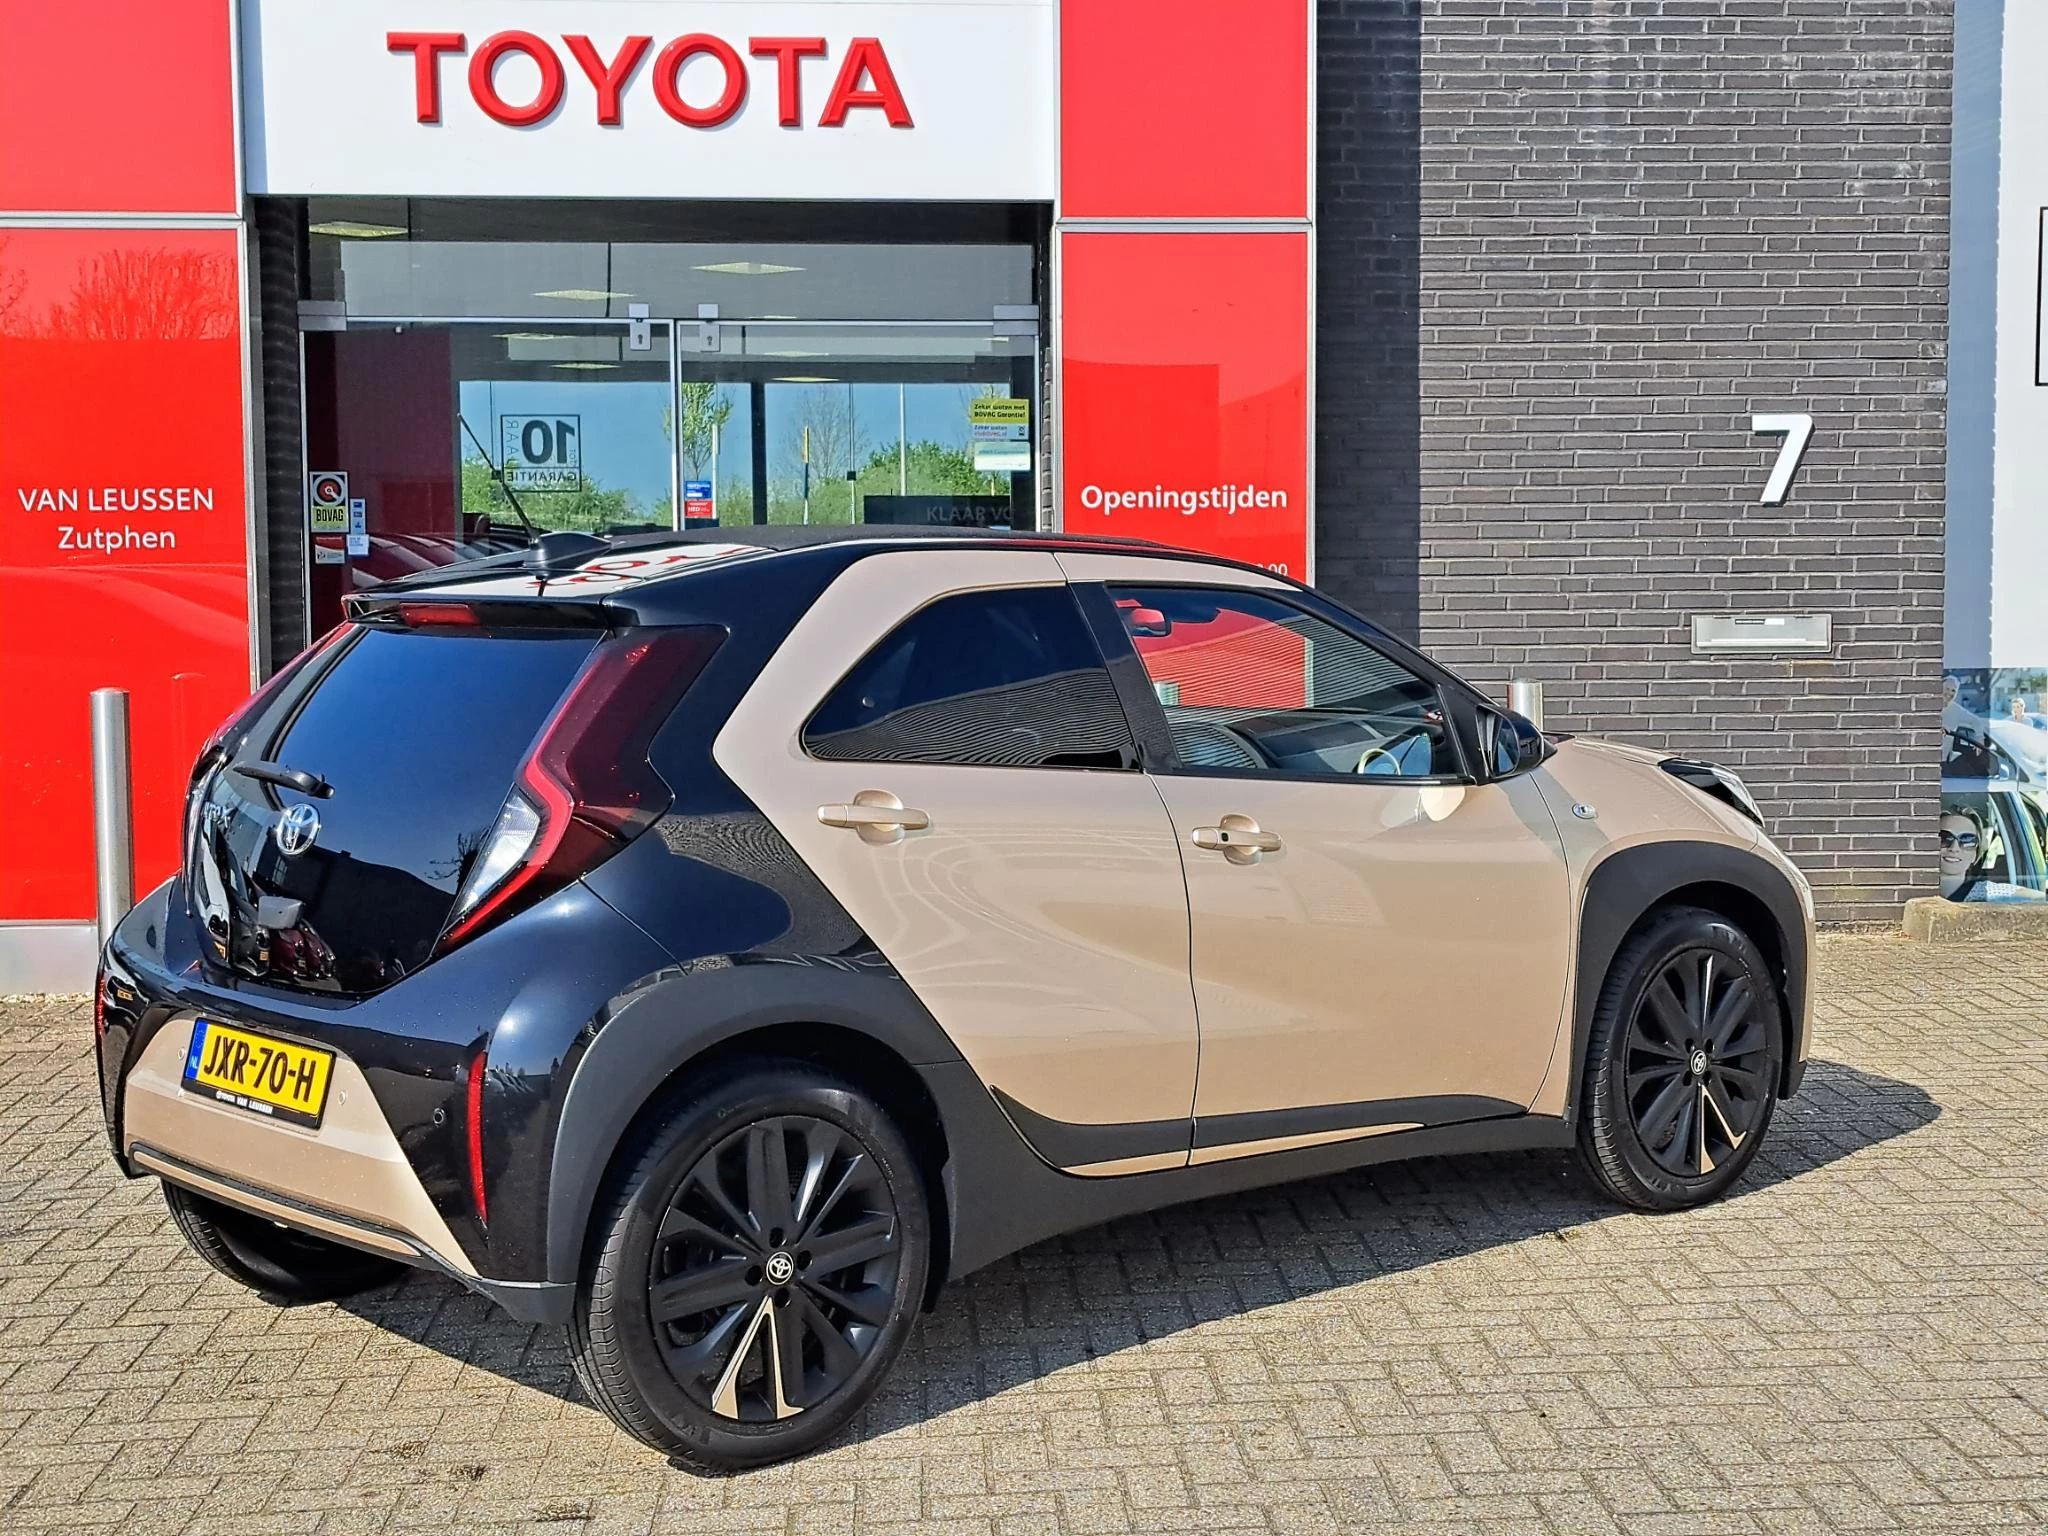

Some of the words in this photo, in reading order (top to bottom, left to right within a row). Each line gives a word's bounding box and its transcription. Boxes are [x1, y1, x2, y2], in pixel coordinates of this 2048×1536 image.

[386, 29, 915, 129] TOYOTA
[1752, 413, 1814, 506] 7
[17, 488, 78, 512] VAN
[88, 488, 214, 512] LEUSSEN
[315, 508, 345, 522] BOVAG
[926, 505, 985, 521] KLAAR
[1080, 484, 1288, 516] Openingstijden
[57, 525, 176, 555] Zutphen
[203, 1035, 317, 1103] JXR-70-H
